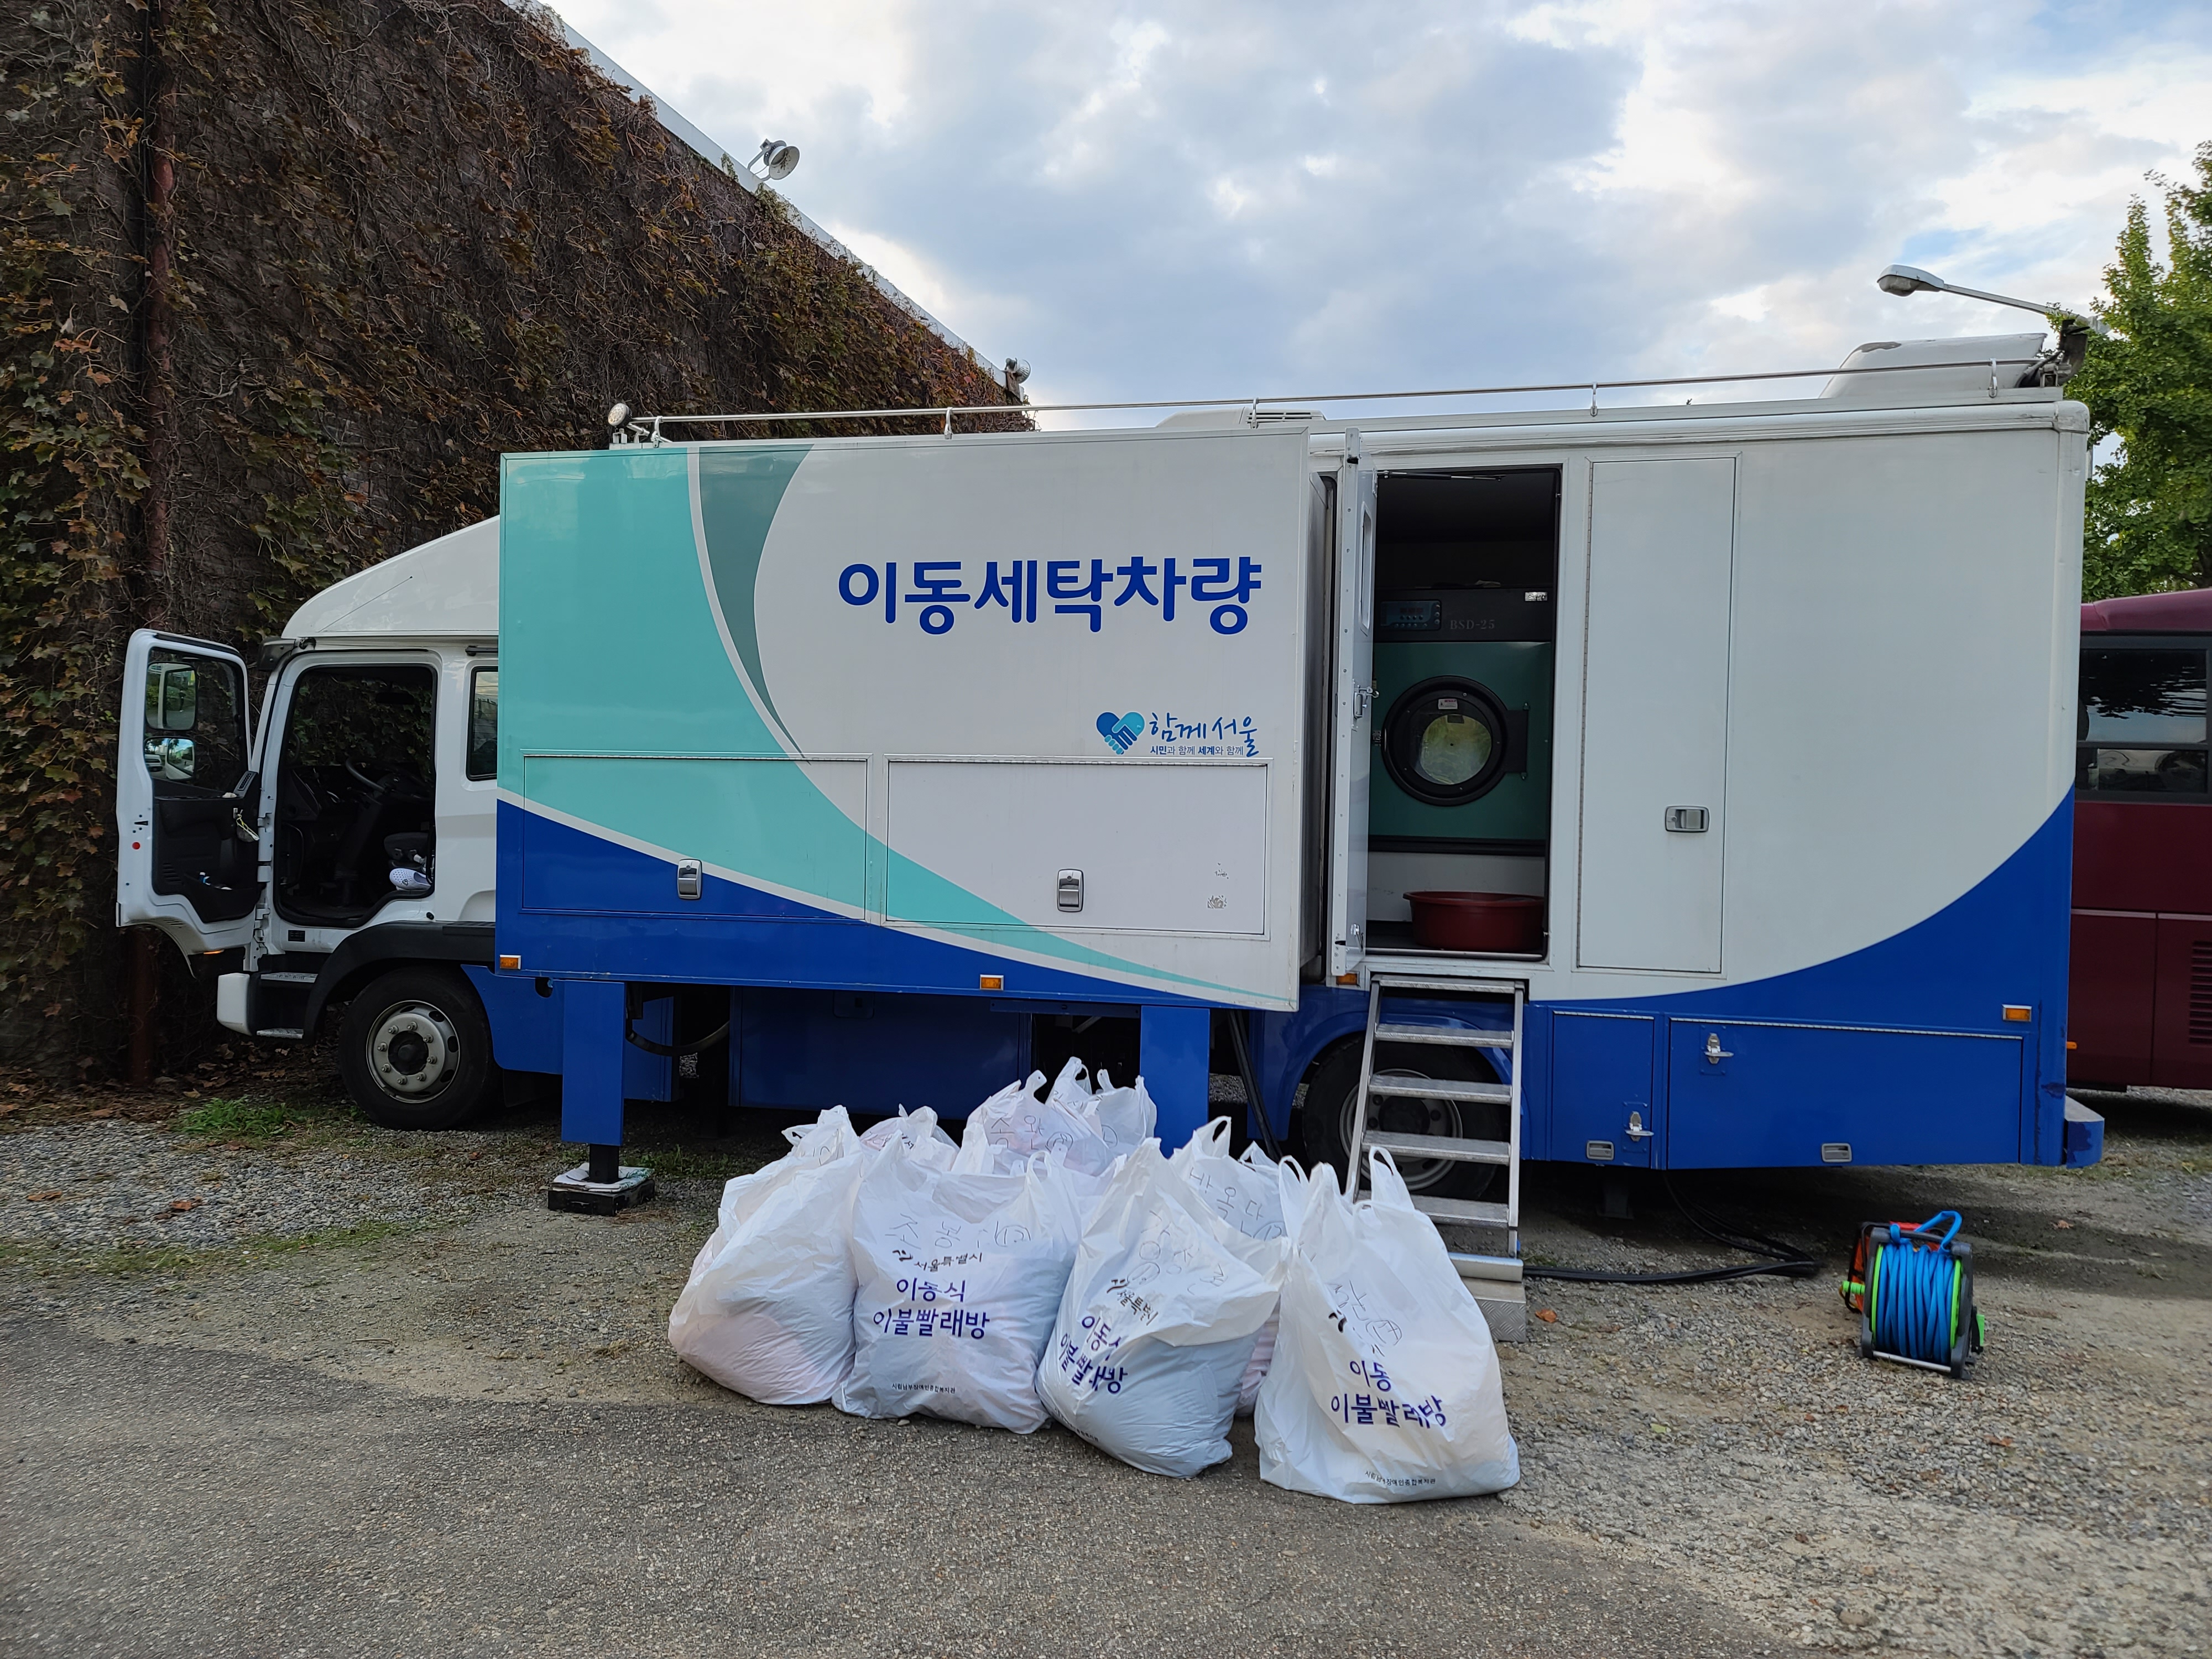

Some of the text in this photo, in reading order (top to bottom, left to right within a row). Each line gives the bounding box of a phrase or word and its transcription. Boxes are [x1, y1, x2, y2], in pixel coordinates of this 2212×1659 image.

[838, 556, 1262, 635] 이동세탁차량
[1449, 619, 1495, 630] BSD-25
[1149, 712, 1260, 758] 함께 서울
[1150, 745, 1244, 756] 시민과 함께 세계와 함께
[914, 1252, 983, 1272] 서울특별시
[896, 1277, 967, 1303] 이동식
[873, 1308, 990, 1340] 이불빨래방
[1331, 1392, 1447, 1429] 이불빨래방
